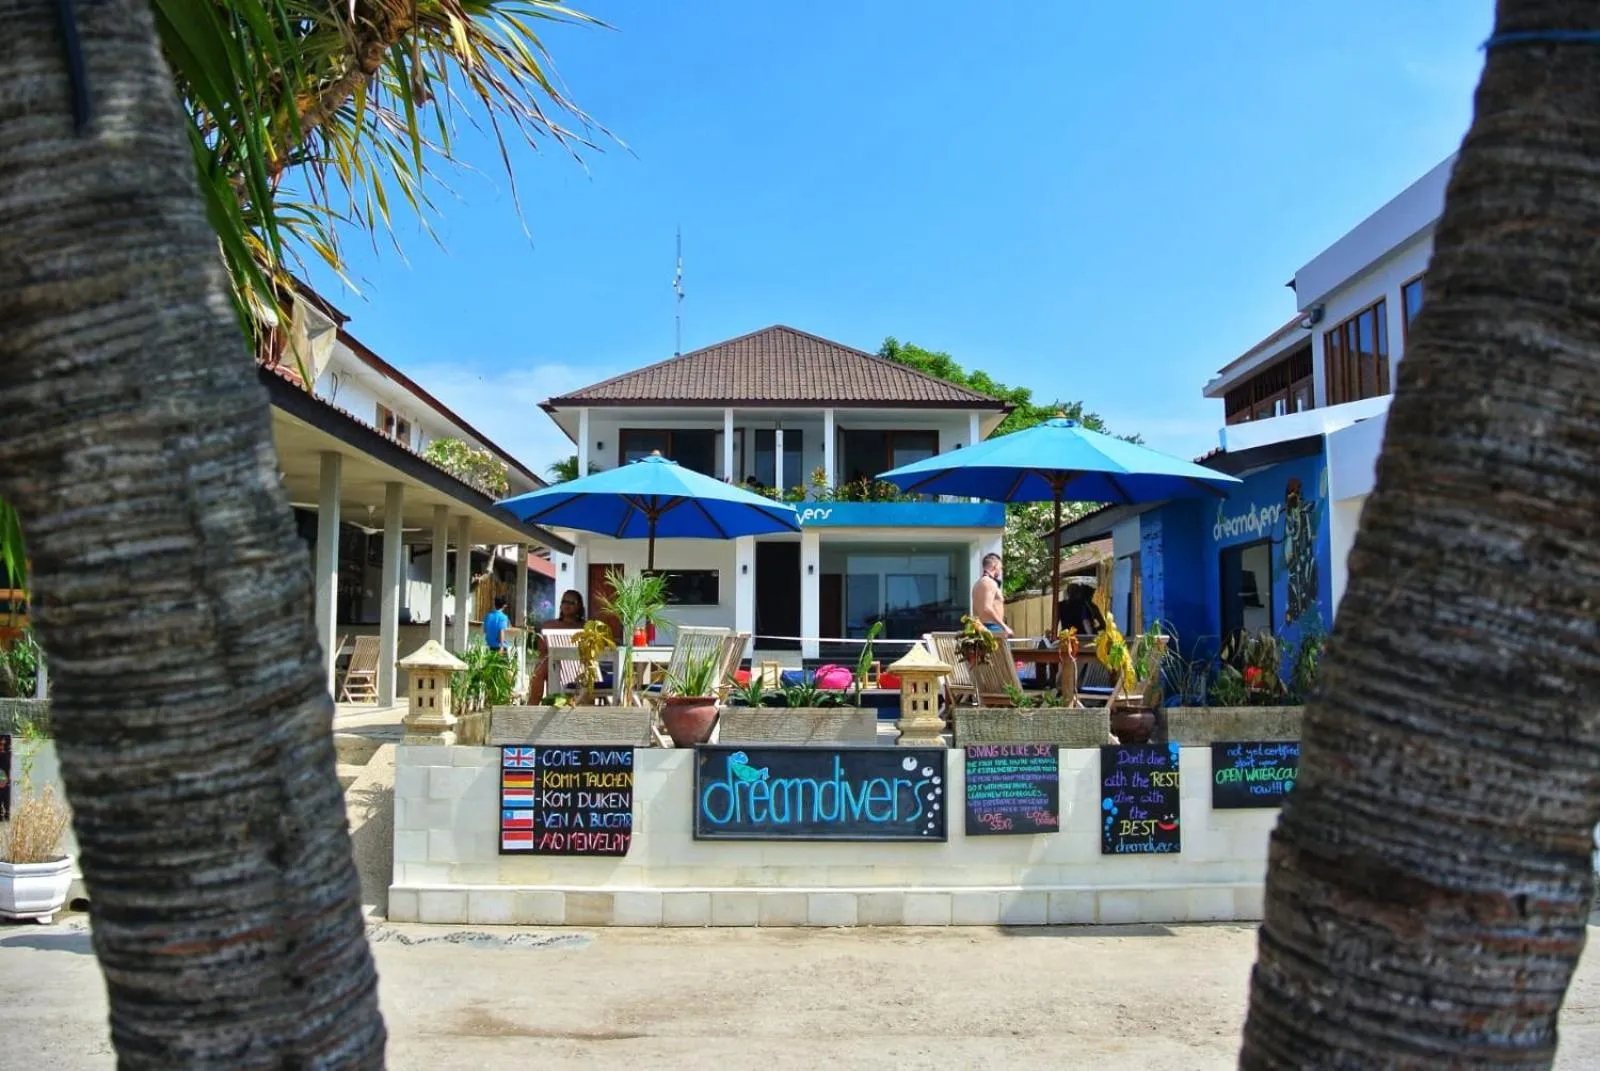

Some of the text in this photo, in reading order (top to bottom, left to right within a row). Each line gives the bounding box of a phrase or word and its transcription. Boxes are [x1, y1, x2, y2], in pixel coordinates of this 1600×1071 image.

[1213, 498, 1281, 541] dreamdivers
[542, 750, 631, 766] COME DIVING
[968, 743, 1052, 758] DIVING IS LIKE SEX
[542, 769, 633, 788] KOMM TAUCHEN
[1131, 772, 1150, 788] the
[1150, 771, 1180, 788] REST
[1215, 767, 1243, 784] OPEN
[702, 754, 930, 824] dreamdivers
[542, 790, 629, 808] KOM DUIKEN
[542, 811, 569, 828] VEN
[572, 813, 584, 828] A
[1130, 805, 1149, 819] the
[1118, 819, 1158, 836] BEST
